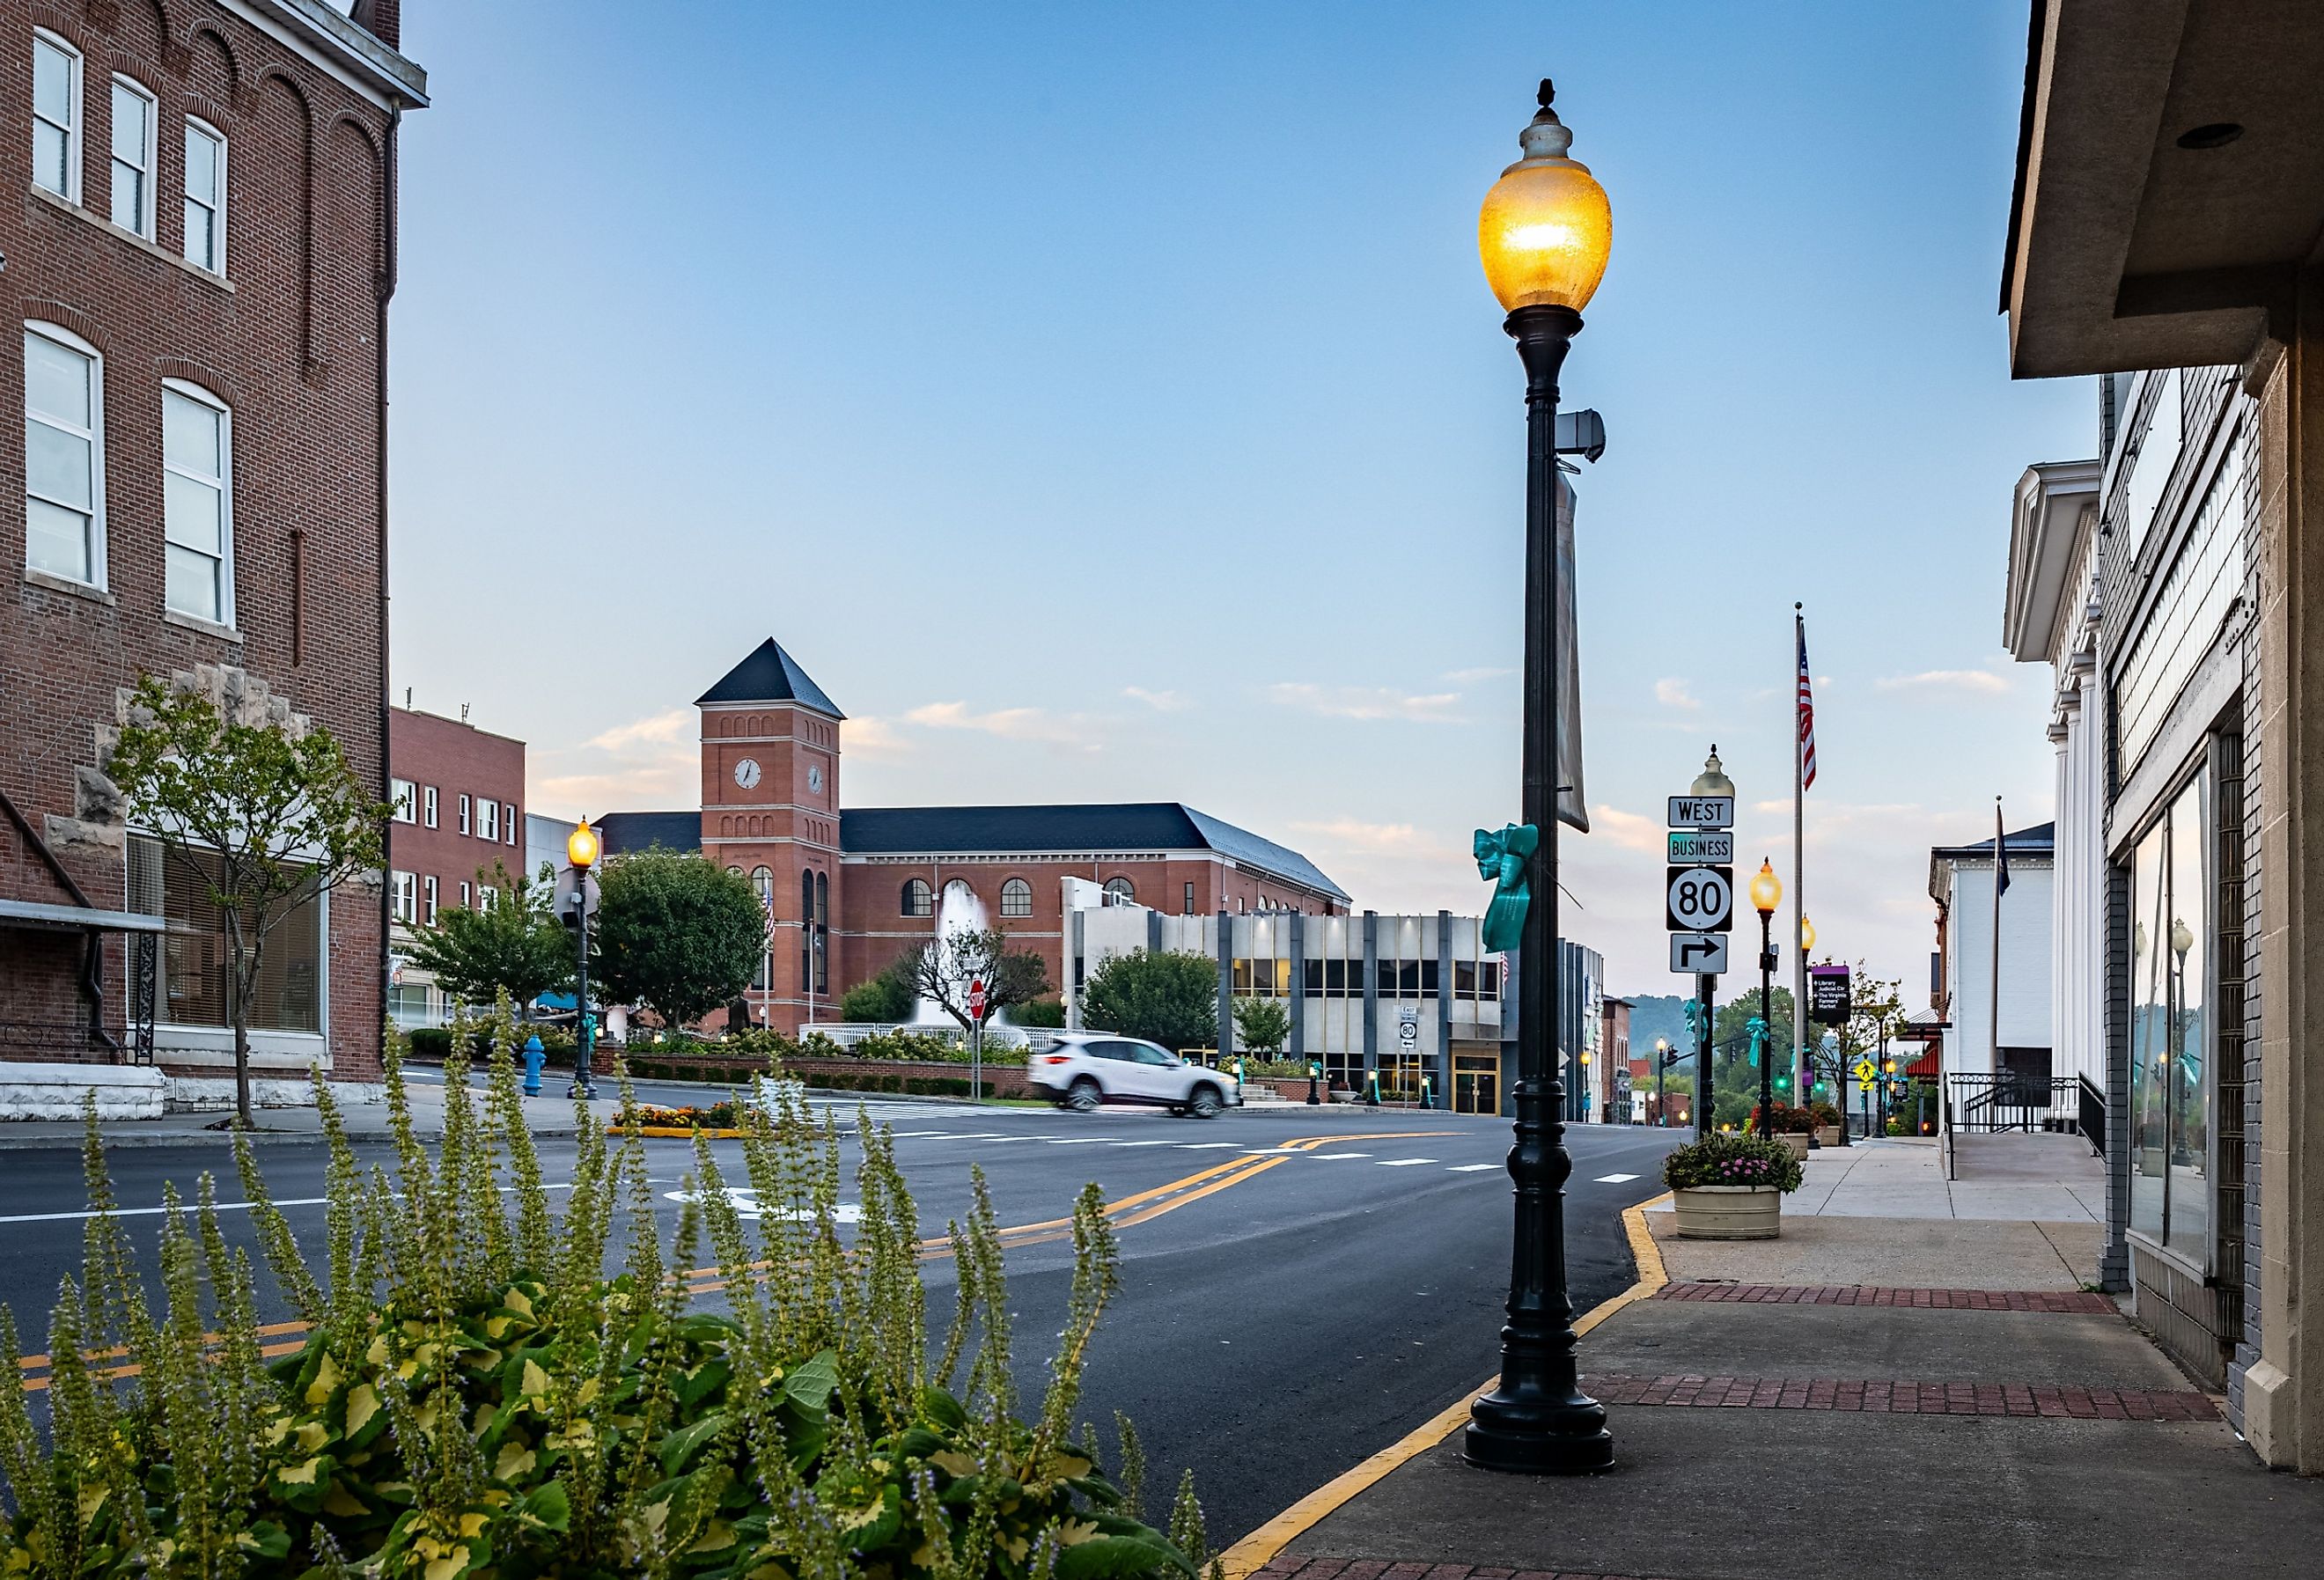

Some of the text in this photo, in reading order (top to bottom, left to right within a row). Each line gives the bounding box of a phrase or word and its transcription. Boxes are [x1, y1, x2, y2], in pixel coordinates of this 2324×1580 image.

[1678, 801, 1725, 820] WEST
[1673, 841, 1728, 856] BUSINESS
[1679, 880, 1722, 916] 80
[970, 991, 985, 1007] STOP
[1402, 1026, 1413, 1035] 80
